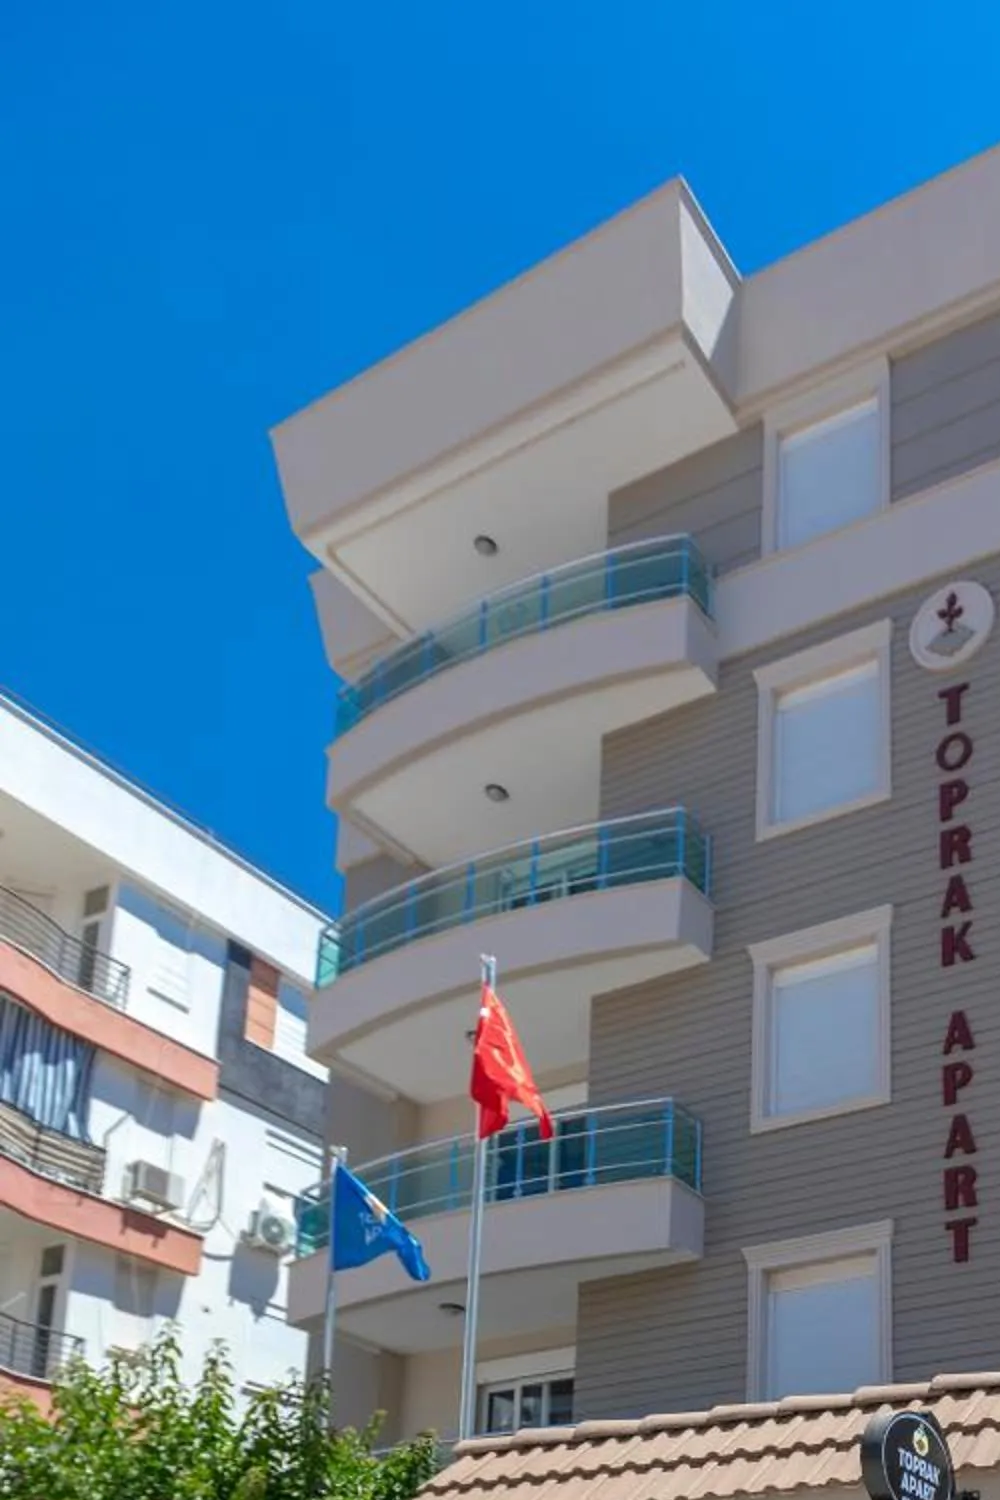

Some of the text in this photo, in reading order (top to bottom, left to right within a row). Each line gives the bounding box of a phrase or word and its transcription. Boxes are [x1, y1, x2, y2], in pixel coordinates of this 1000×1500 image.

[936, 682, 978, 1263] TOPRAK APART
[898, 1447, 940, 1487] TOPRAK
